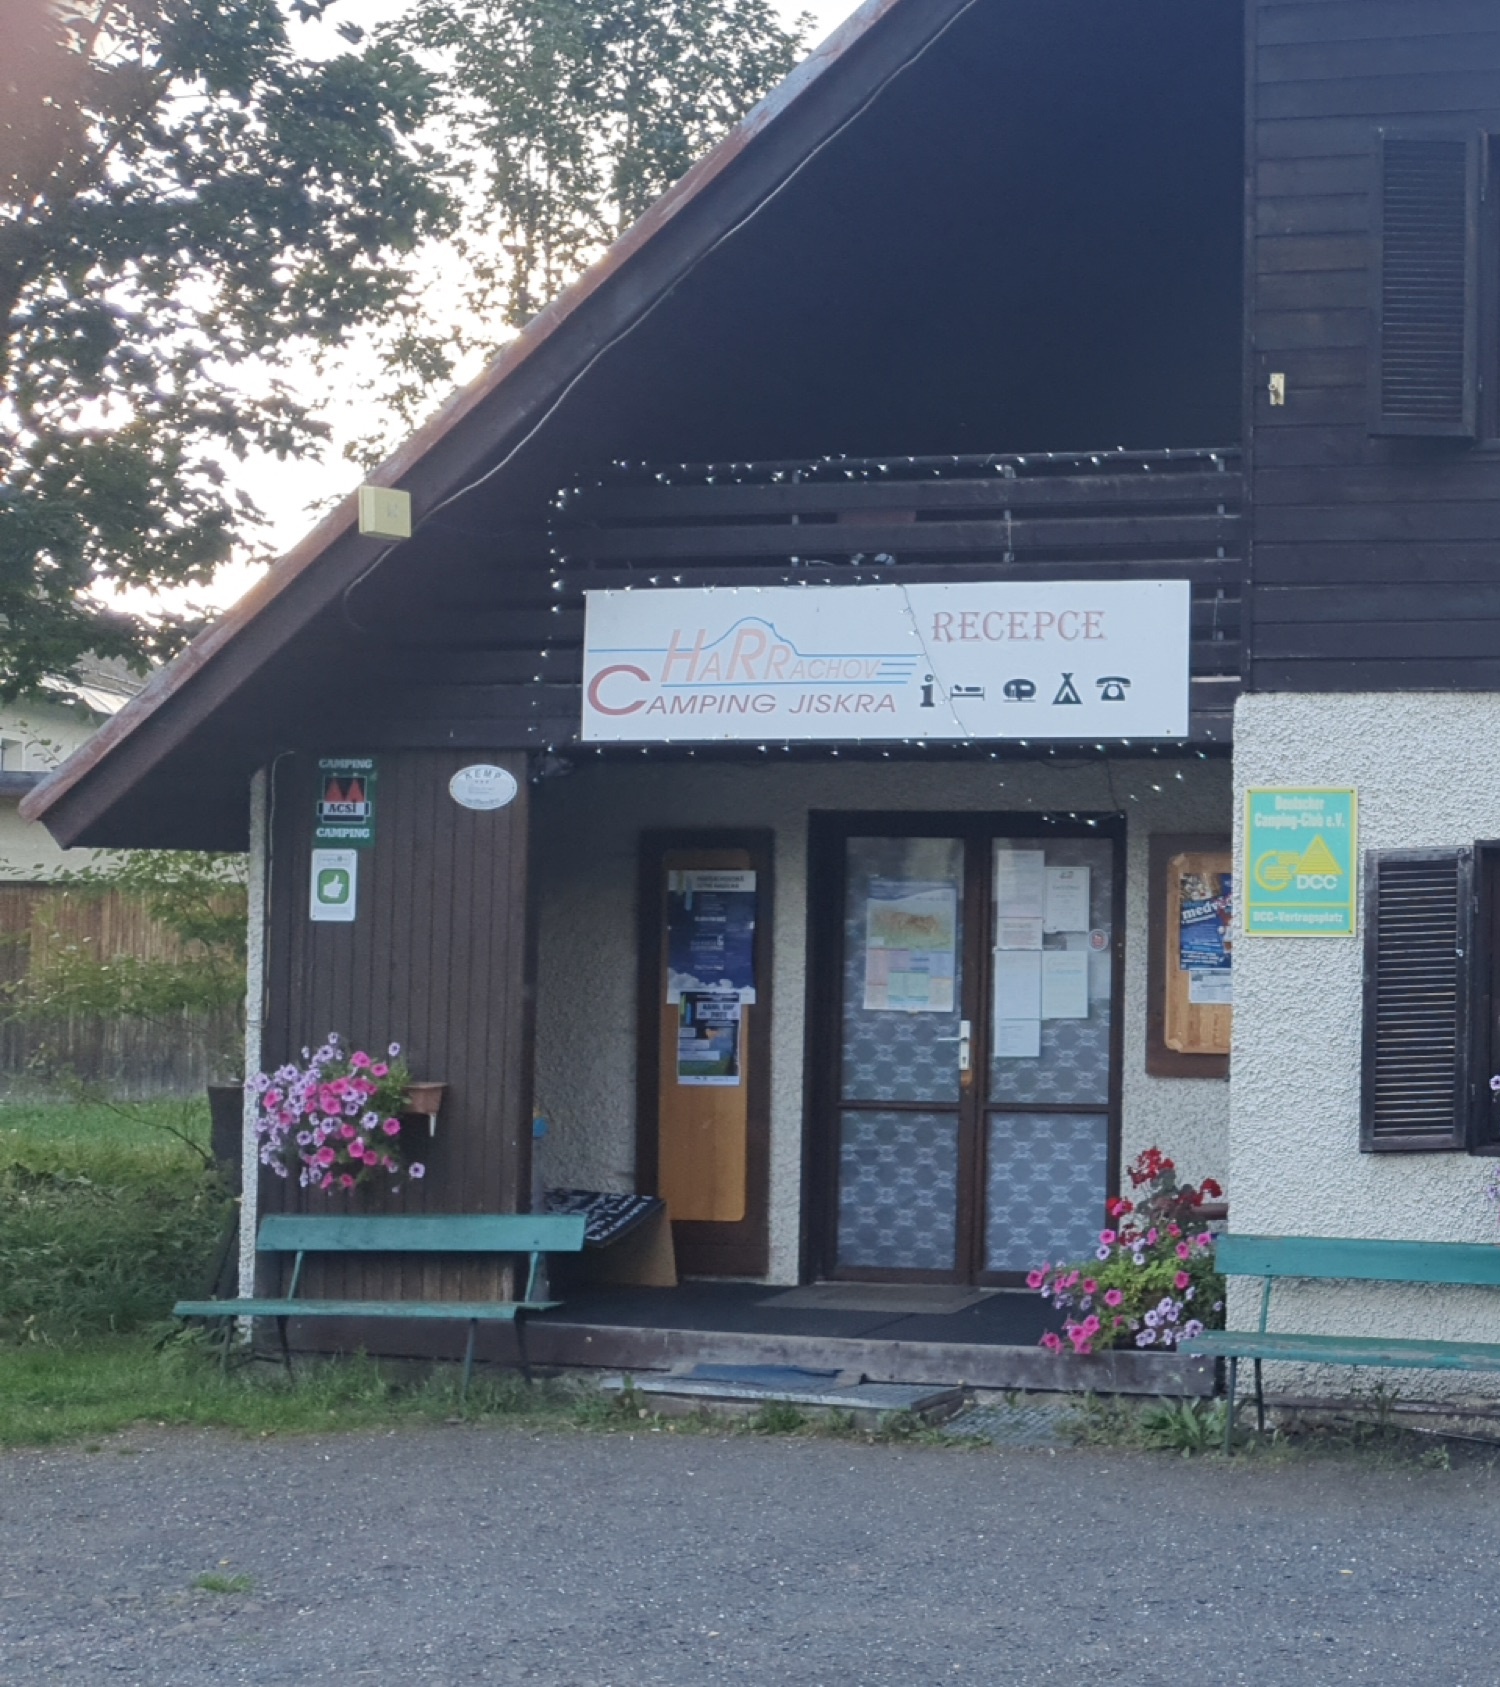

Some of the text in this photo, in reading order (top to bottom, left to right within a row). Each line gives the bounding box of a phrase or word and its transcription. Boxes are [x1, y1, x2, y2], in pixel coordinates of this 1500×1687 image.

[932, 610, 1106, 643] RECEPCE
[587, 664, 898, 717] CAMPING JISKRA
[318, 758, 373, 769] CAMPING
[464, 769, 502, 781] KEMP
[316, 828, 371, 839] CAMPING
[1296, 874, 1338, 890] DCC
